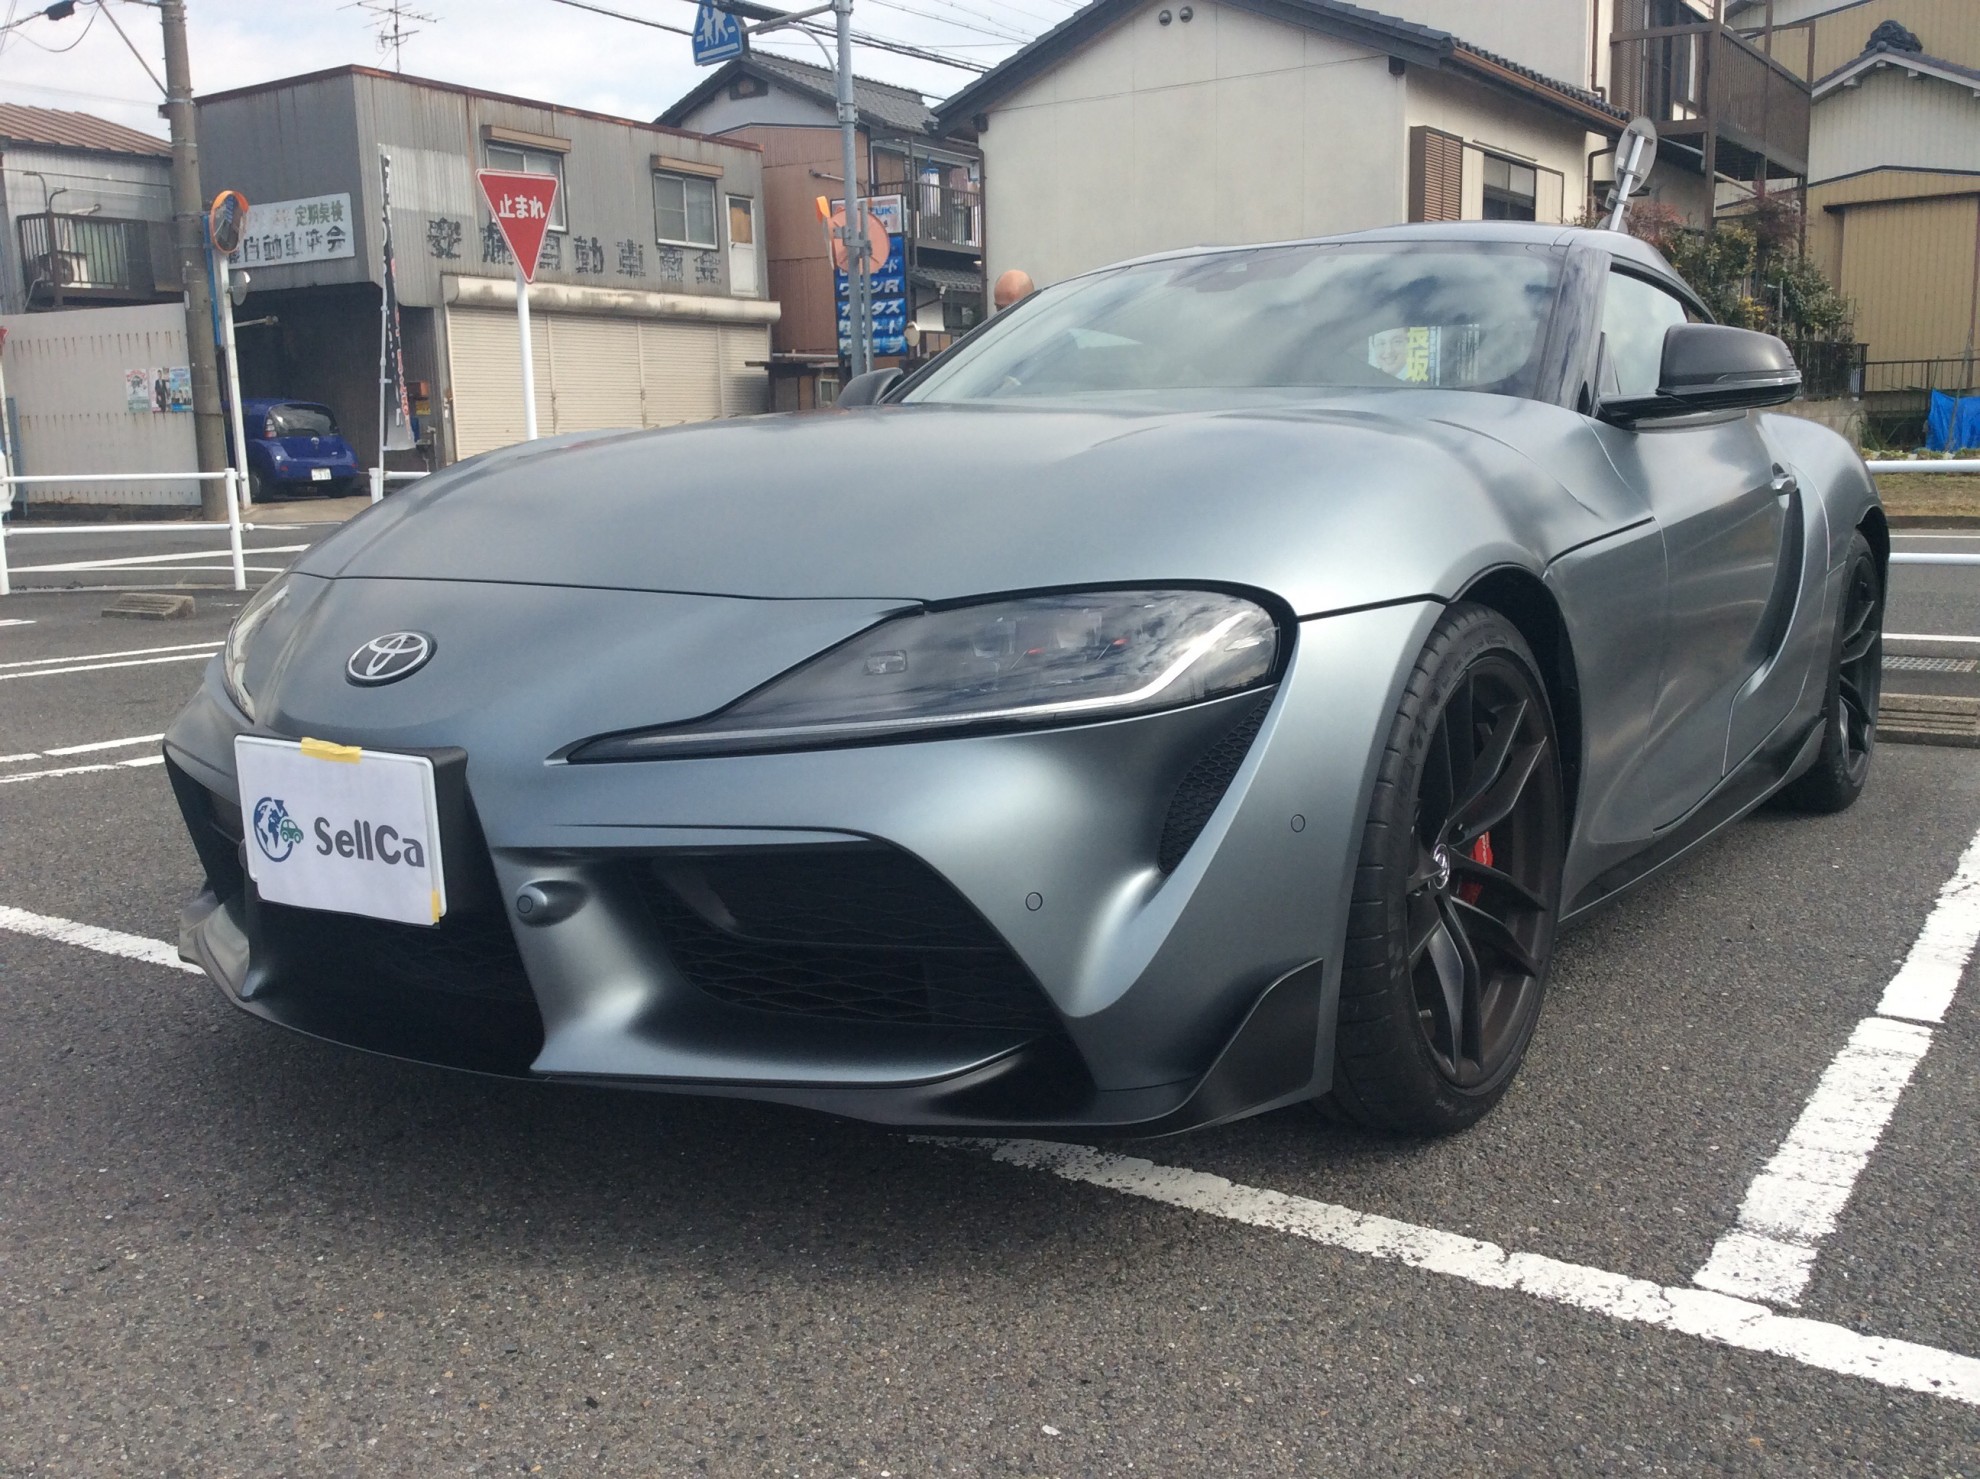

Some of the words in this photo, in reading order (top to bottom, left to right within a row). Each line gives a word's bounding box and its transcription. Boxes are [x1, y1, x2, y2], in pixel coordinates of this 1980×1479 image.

[499, 194, 546, 220] 止まれ
[314, 816, 425, 868] SellCa
